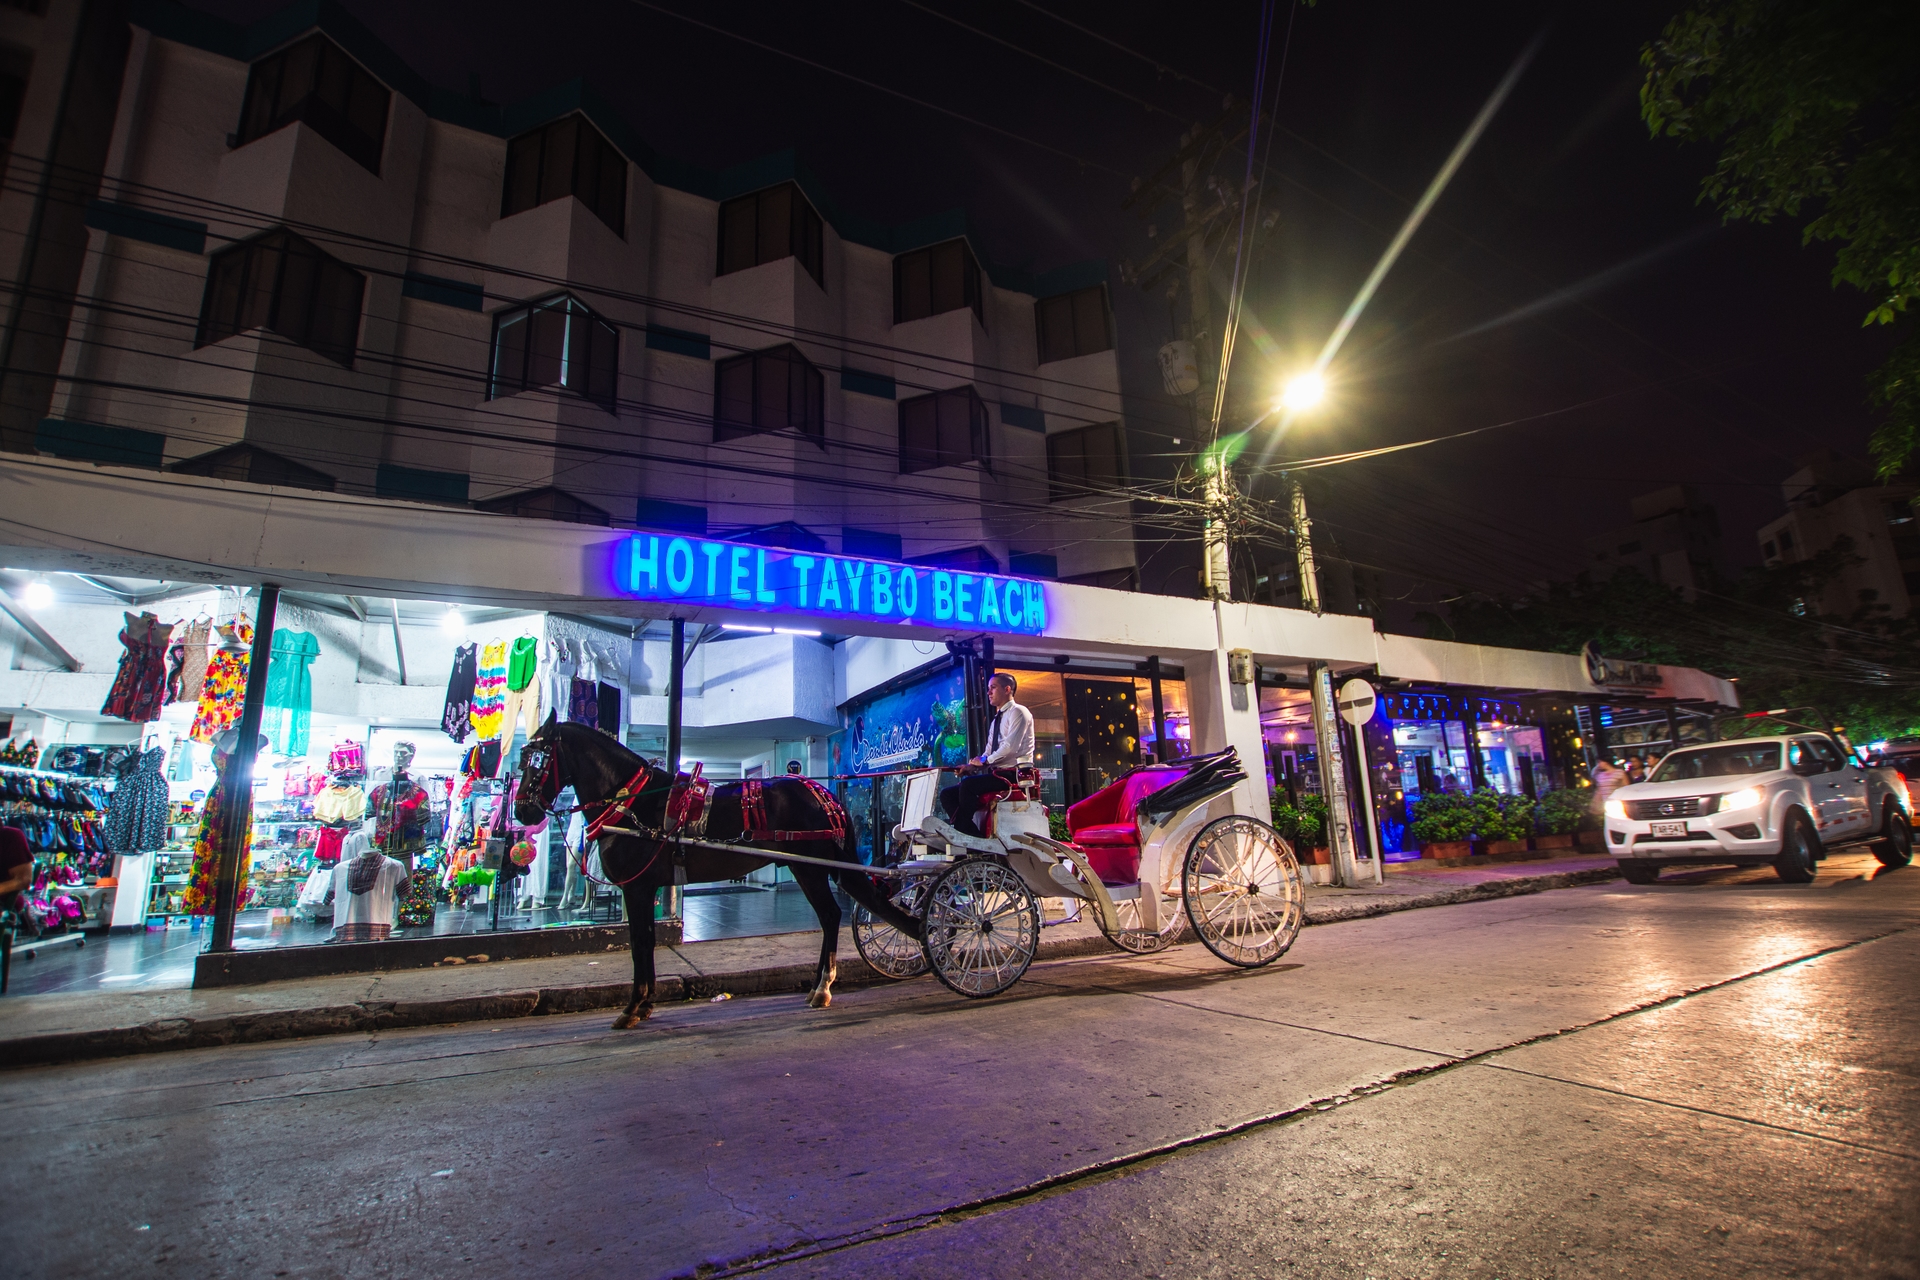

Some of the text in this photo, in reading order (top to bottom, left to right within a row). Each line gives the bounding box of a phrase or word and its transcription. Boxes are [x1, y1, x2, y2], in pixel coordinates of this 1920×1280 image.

[631, 536, 1046, 629] HOTEL TAYBO BEACH
